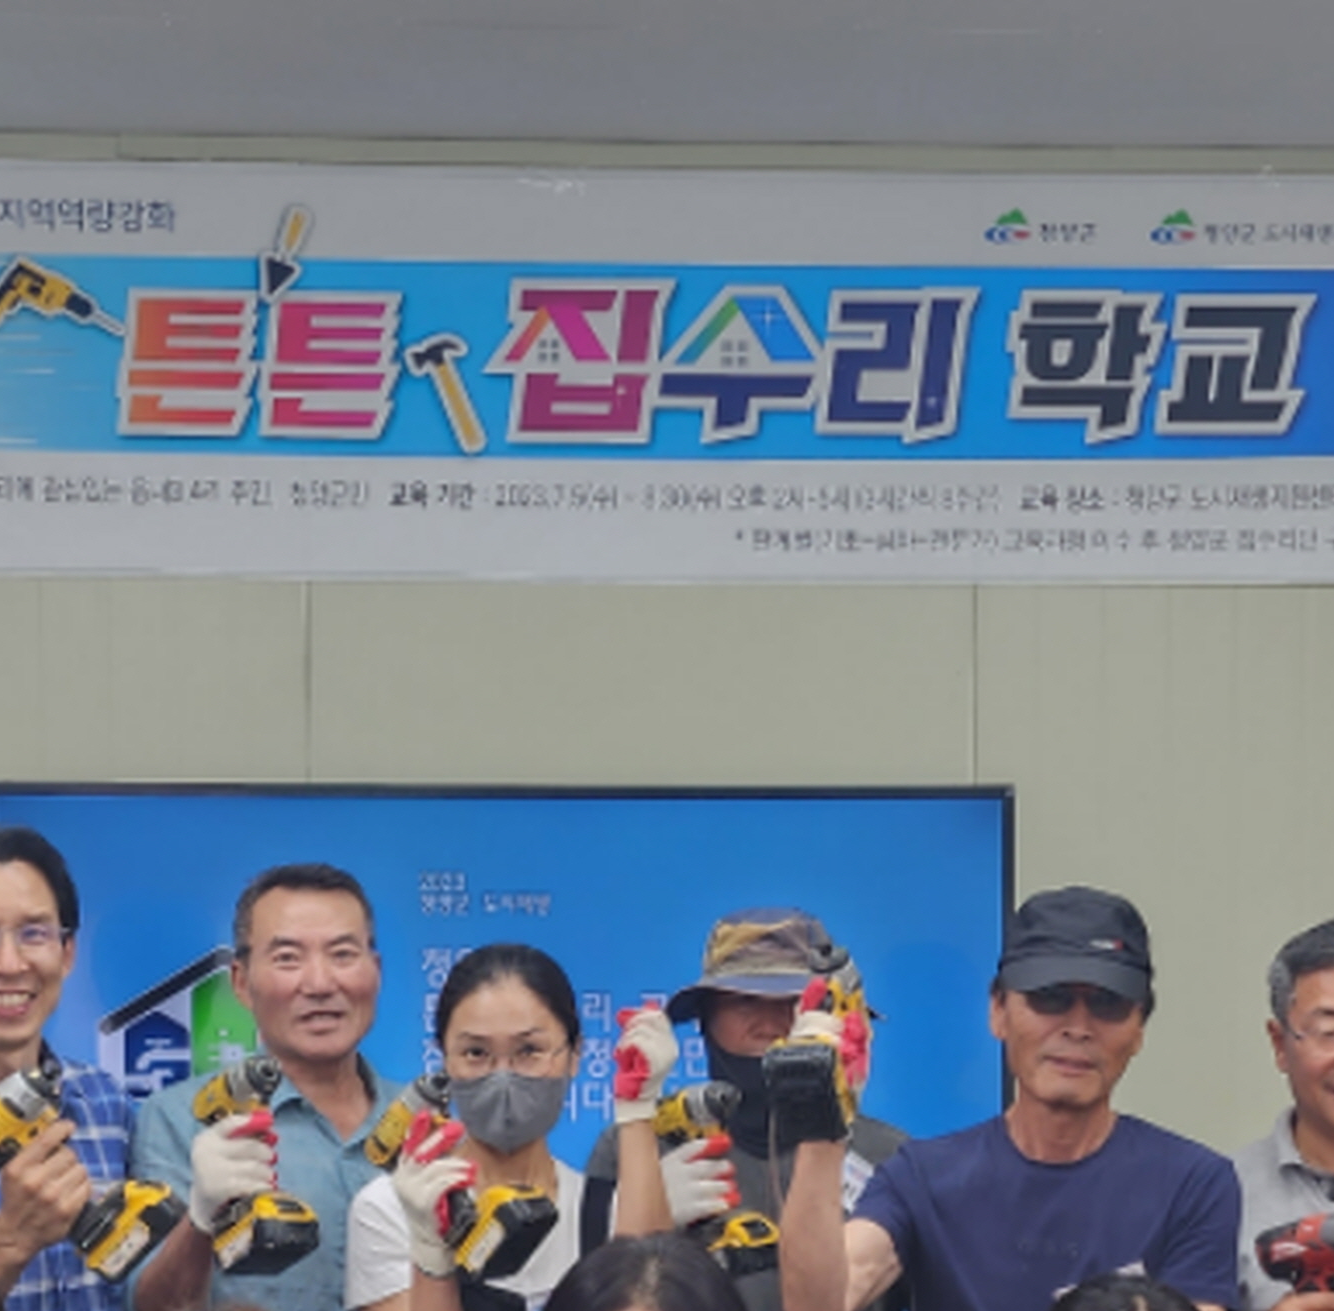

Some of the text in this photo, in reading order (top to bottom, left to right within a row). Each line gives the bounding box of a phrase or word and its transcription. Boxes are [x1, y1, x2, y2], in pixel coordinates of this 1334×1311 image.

[117, 277, 1317, 445] 튼튼 집수리 학교
